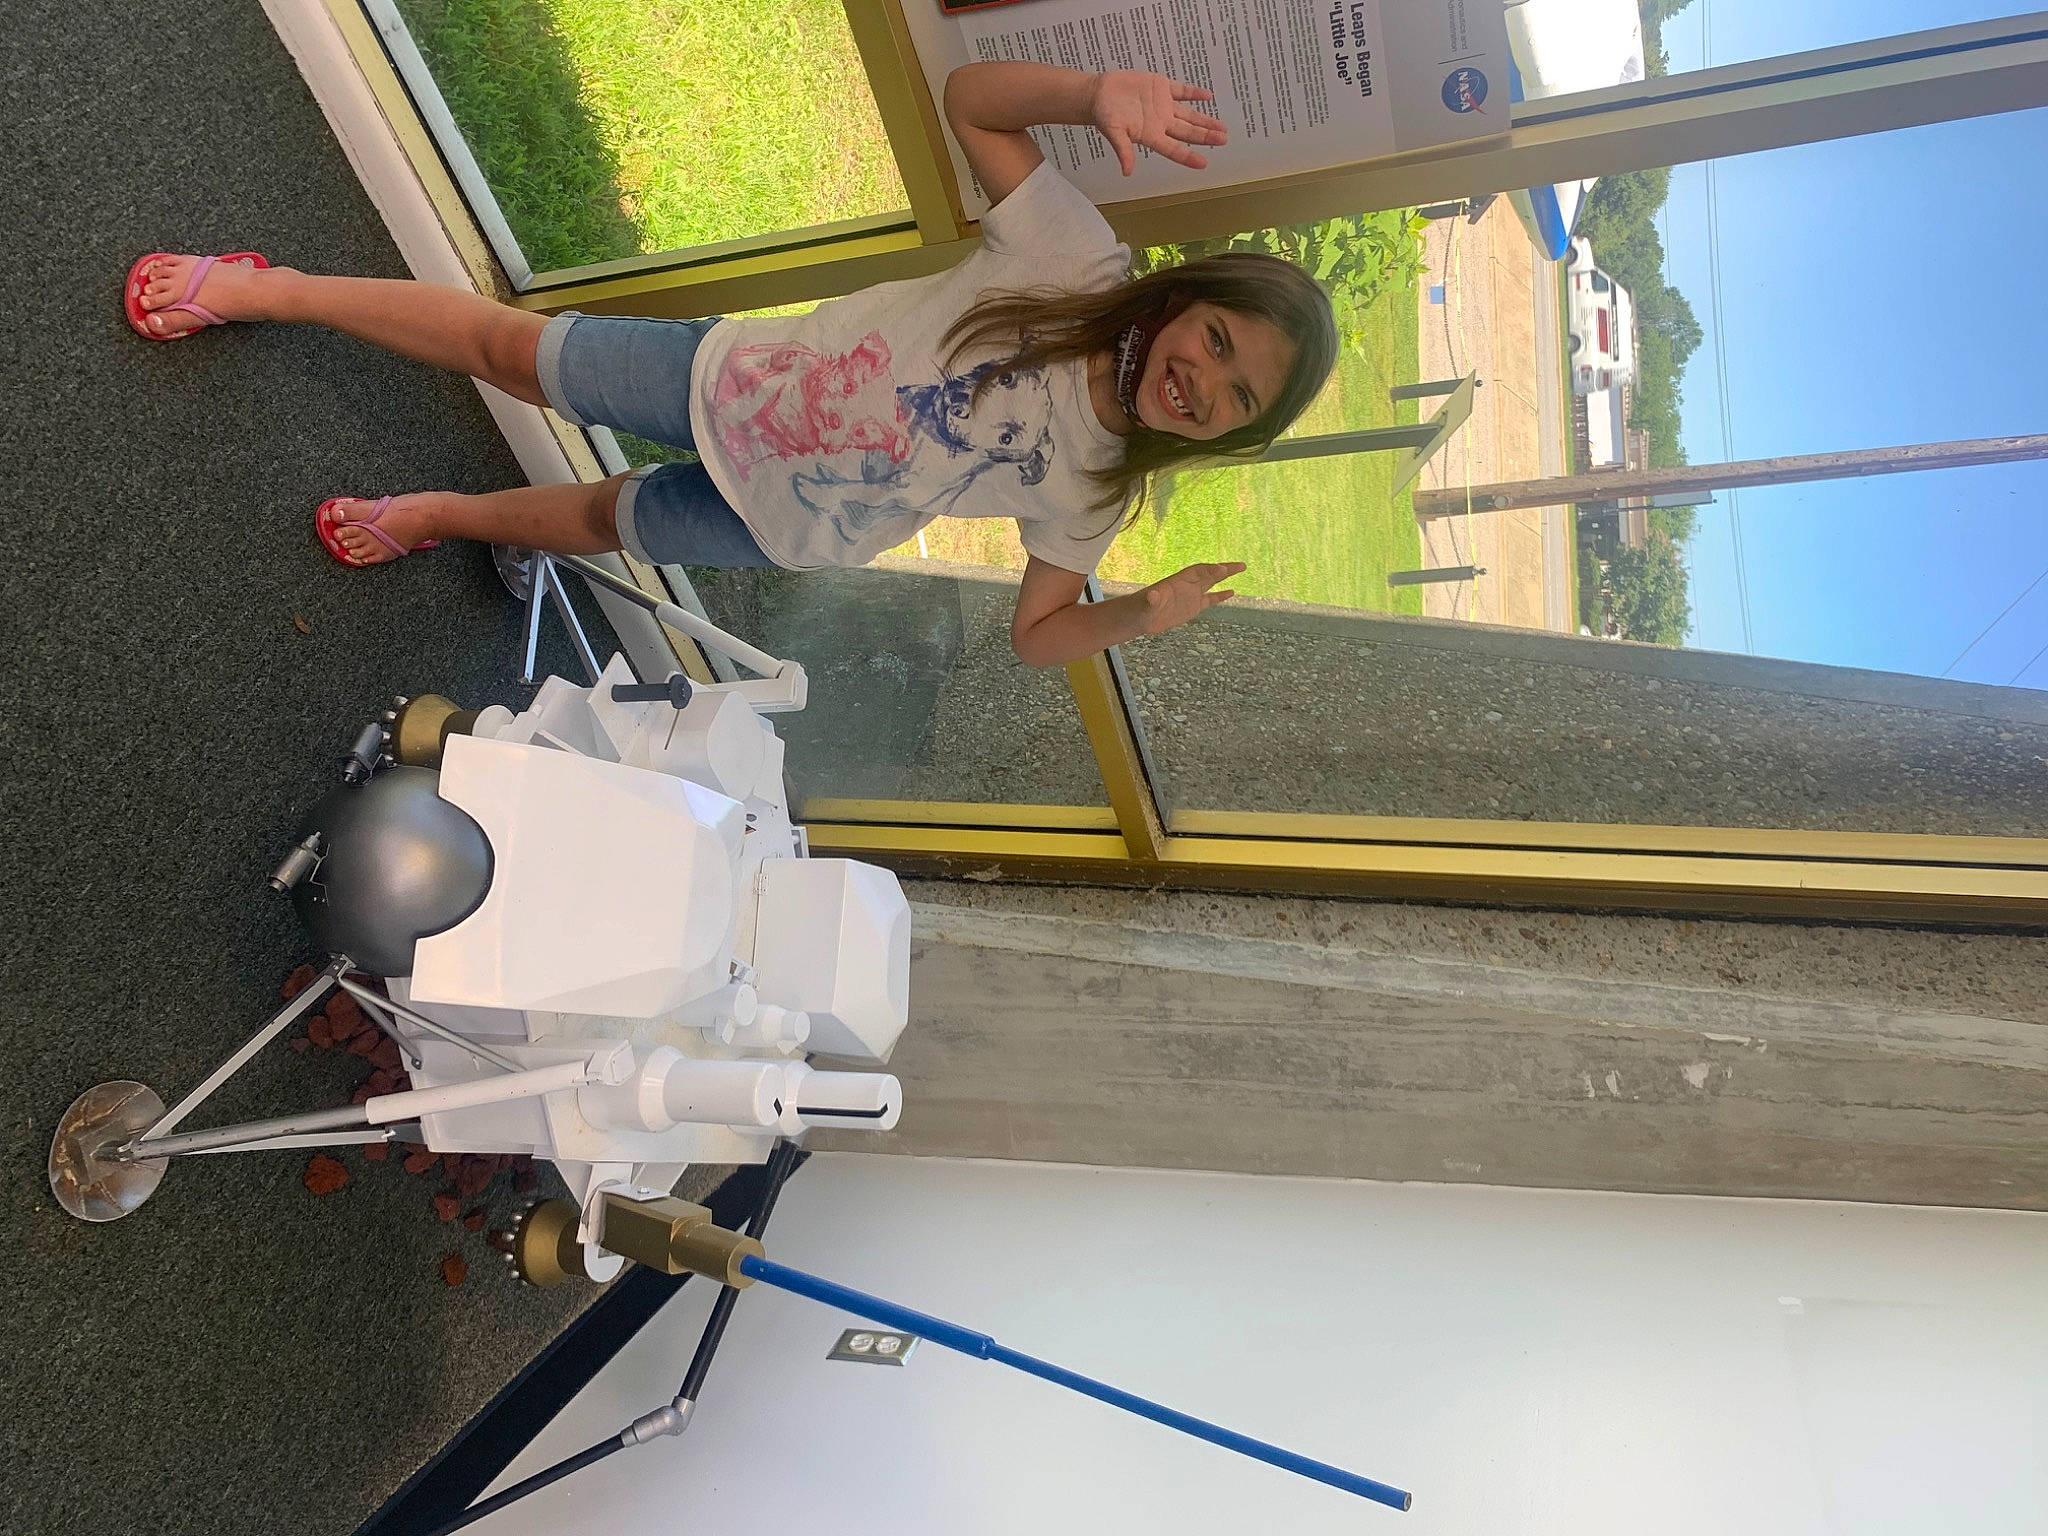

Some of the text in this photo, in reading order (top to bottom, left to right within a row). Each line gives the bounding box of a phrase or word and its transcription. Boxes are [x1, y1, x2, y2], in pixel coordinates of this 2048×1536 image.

[1350, 2, 1372, 98] Leaps Began
[1457, 71, 1470, 111] NASA
